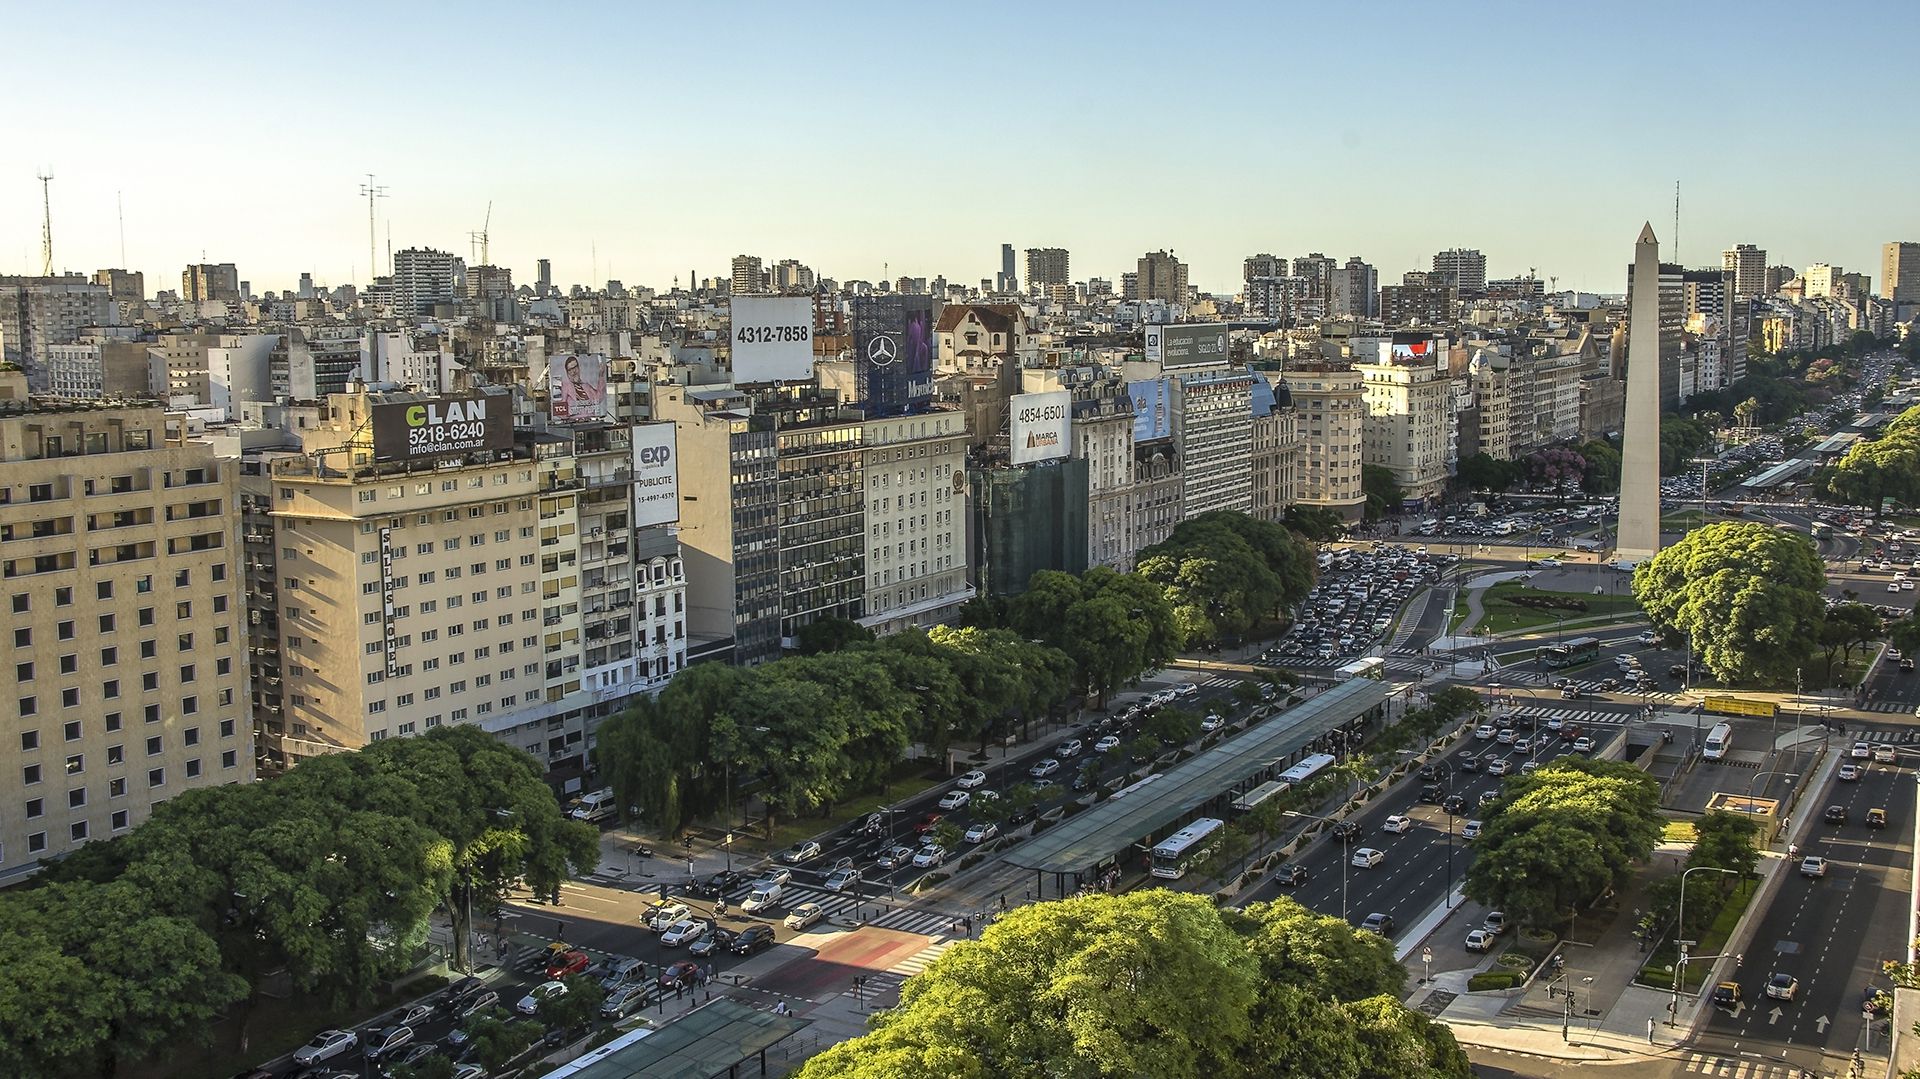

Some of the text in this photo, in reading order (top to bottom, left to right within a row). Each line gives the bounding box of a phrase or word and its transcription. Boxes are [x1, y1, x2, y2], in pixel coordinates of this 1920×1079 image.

[737, 326, 808, 343] 4312-7858
[406, 399, 486, 427] CLAN
[1019, 405, 1065, 424] 4854-6501
[409, 422, 485, 444] 5218-6240
[1035, 432, 1058, 440] MARCA
[409, 439, 485, 455] info@clan.com.ar
[639, 475, 673, 488] PUBLICITE
[383, 533, 394, 604] SALLES
